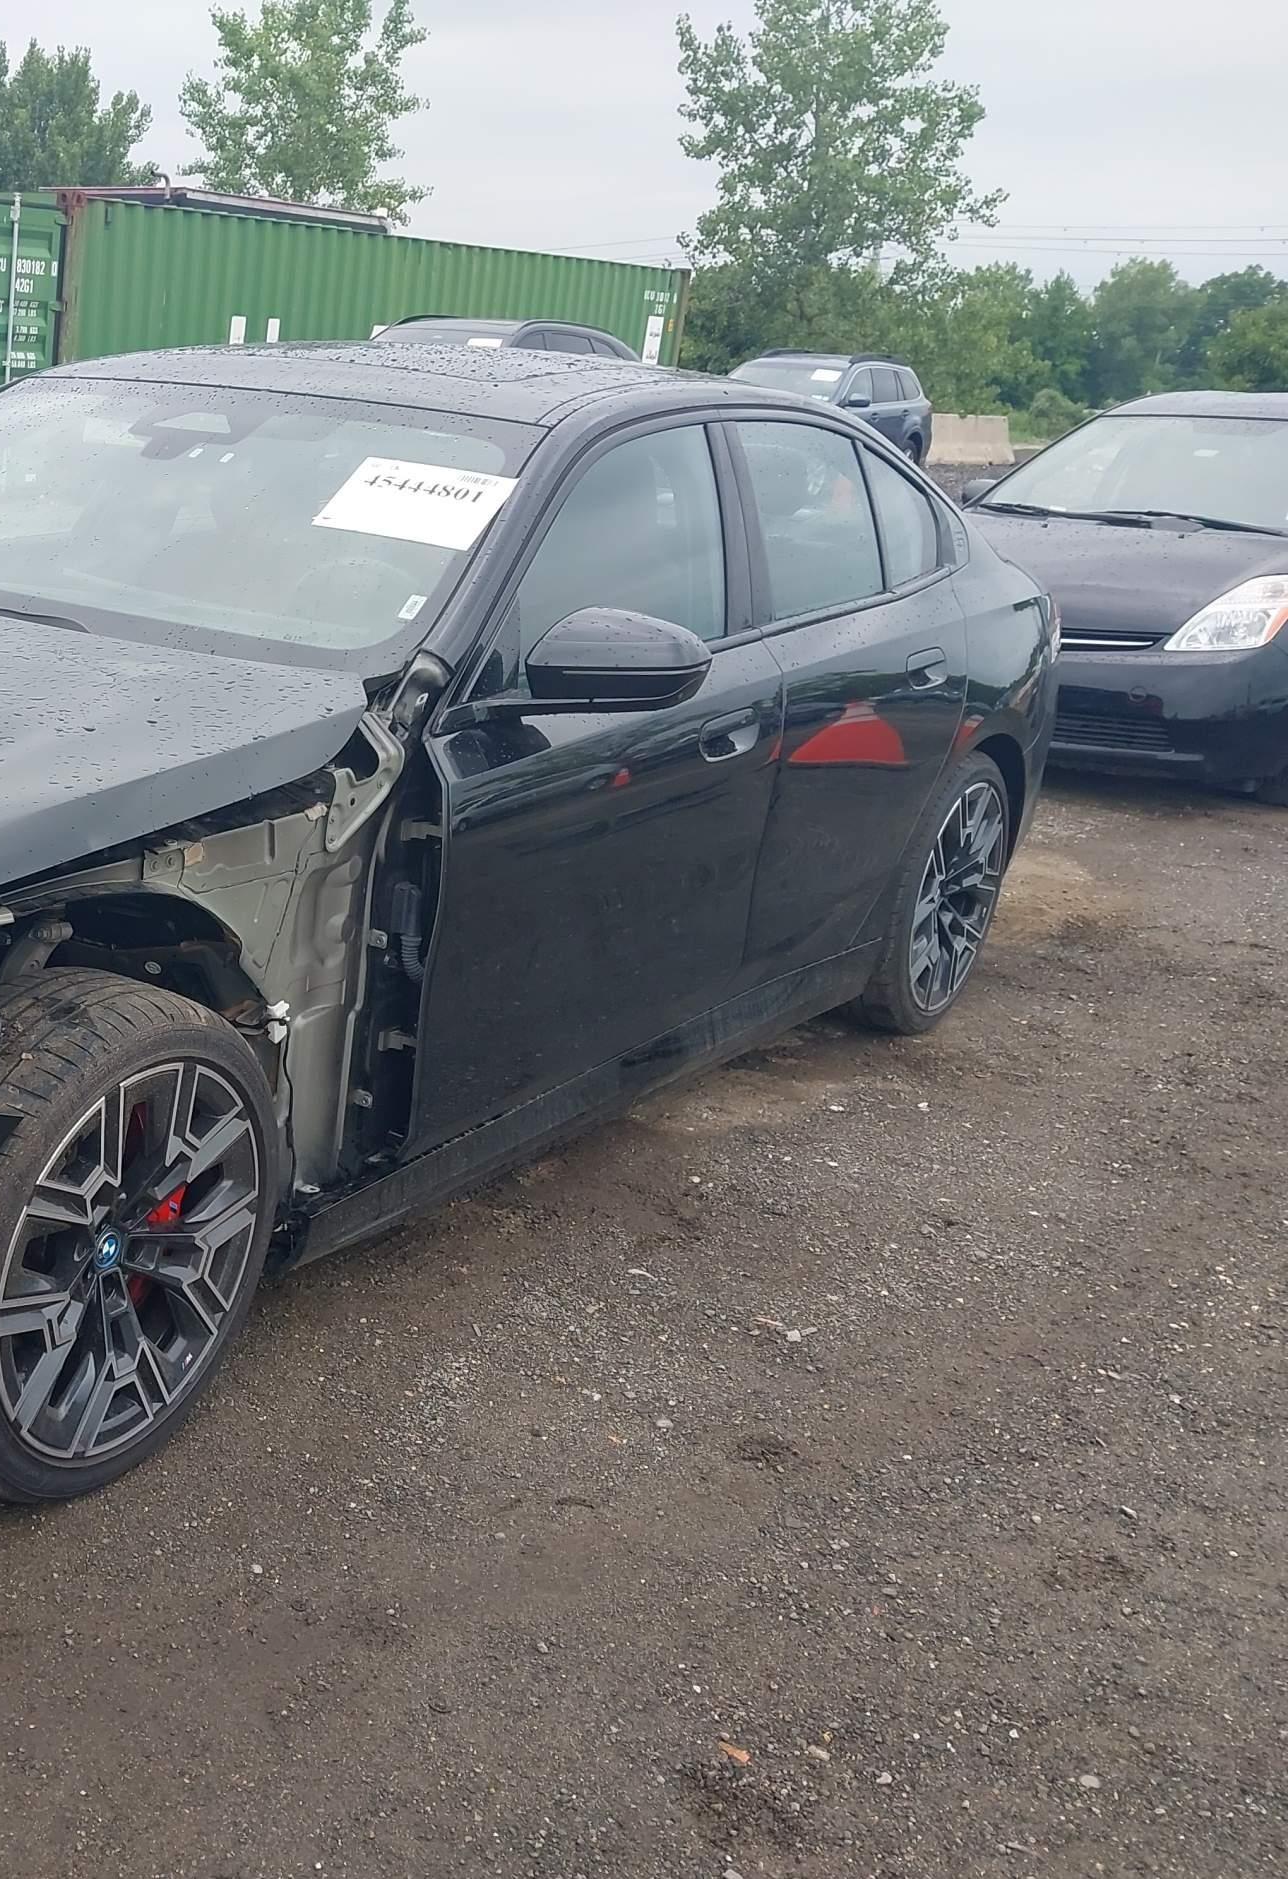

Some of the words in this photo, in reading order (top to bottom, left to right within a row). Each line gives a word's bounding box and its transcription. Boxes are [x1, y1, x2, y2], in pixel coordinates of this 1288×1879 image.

[16, 258, 45, 275] 830182
[14, 277, 34, 294] 42G1
[364, 475, 483, 503] 45444801
